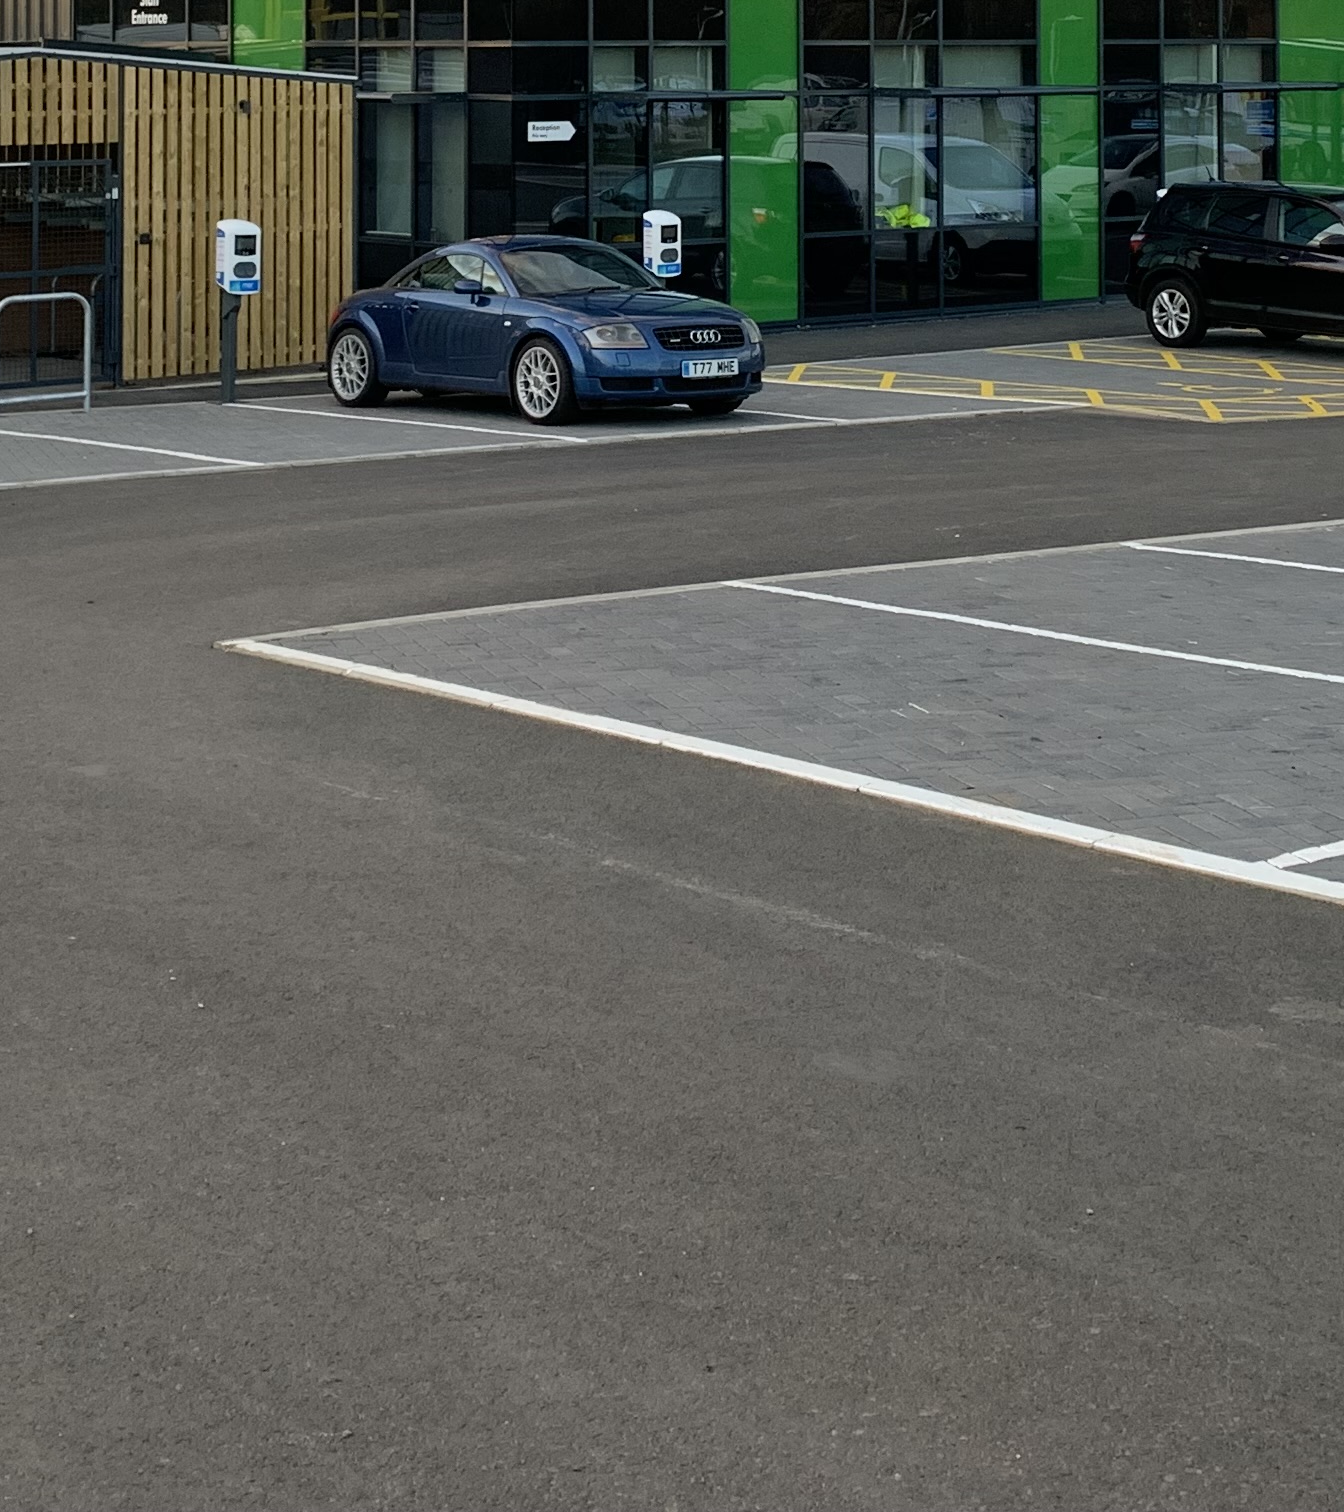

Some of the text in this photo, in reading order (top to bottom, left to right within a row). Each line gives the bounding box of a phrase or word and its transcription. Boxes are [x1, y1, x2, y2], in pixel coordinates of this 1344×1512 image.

[131, 9, 168, 25] Entrance
[532, 123, 561, 131] Reception
[692, 360, 735, 375] T77 MHE
